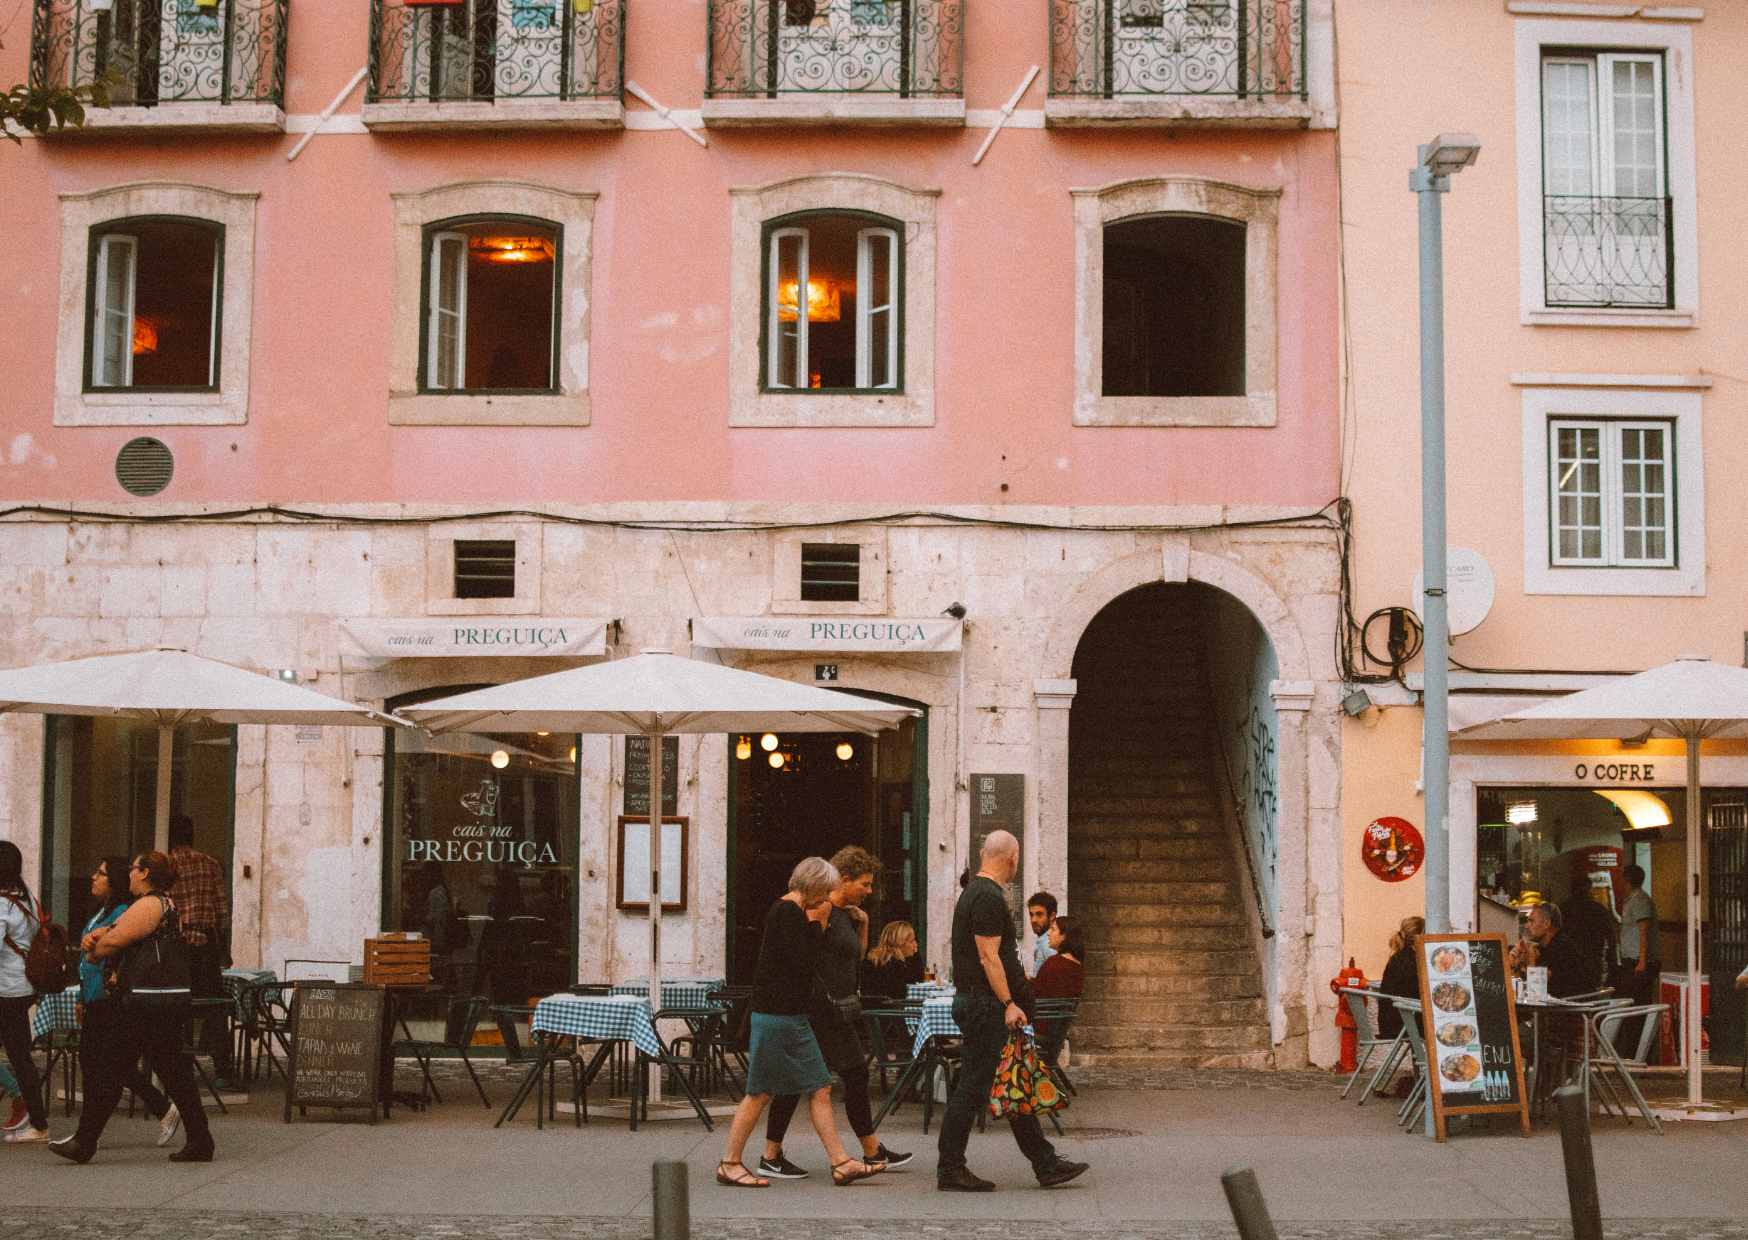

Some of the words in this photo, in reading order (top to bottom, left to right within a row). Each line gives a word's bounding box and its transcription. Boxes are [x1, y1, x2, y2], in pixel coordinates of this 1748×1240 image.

[388, 633, 412, 646] cais
[417, 635, 434, 646] na
[454, 628, 568, 649] PREGUIÇA
[744, 625, 769, 638] cais
[773, 628, 790, 638] na
[810, 623, 926, 645] PREGUIÇA
[1575, 763, 1588, 780] O
[1594, 764, 1655, 781] COFRE
[452, 821, 486, 838] cais
[490, 825, 513, 838] na
[408, 839, 558, 870] PREGUIÇA
[299, 1003, 316, 1019] ALL
[317, 1004, 337, 1019] DAY
[338, 1006, 376, 1022] BRUNCH
[1482, 1043, 1512, 1065] ENU
